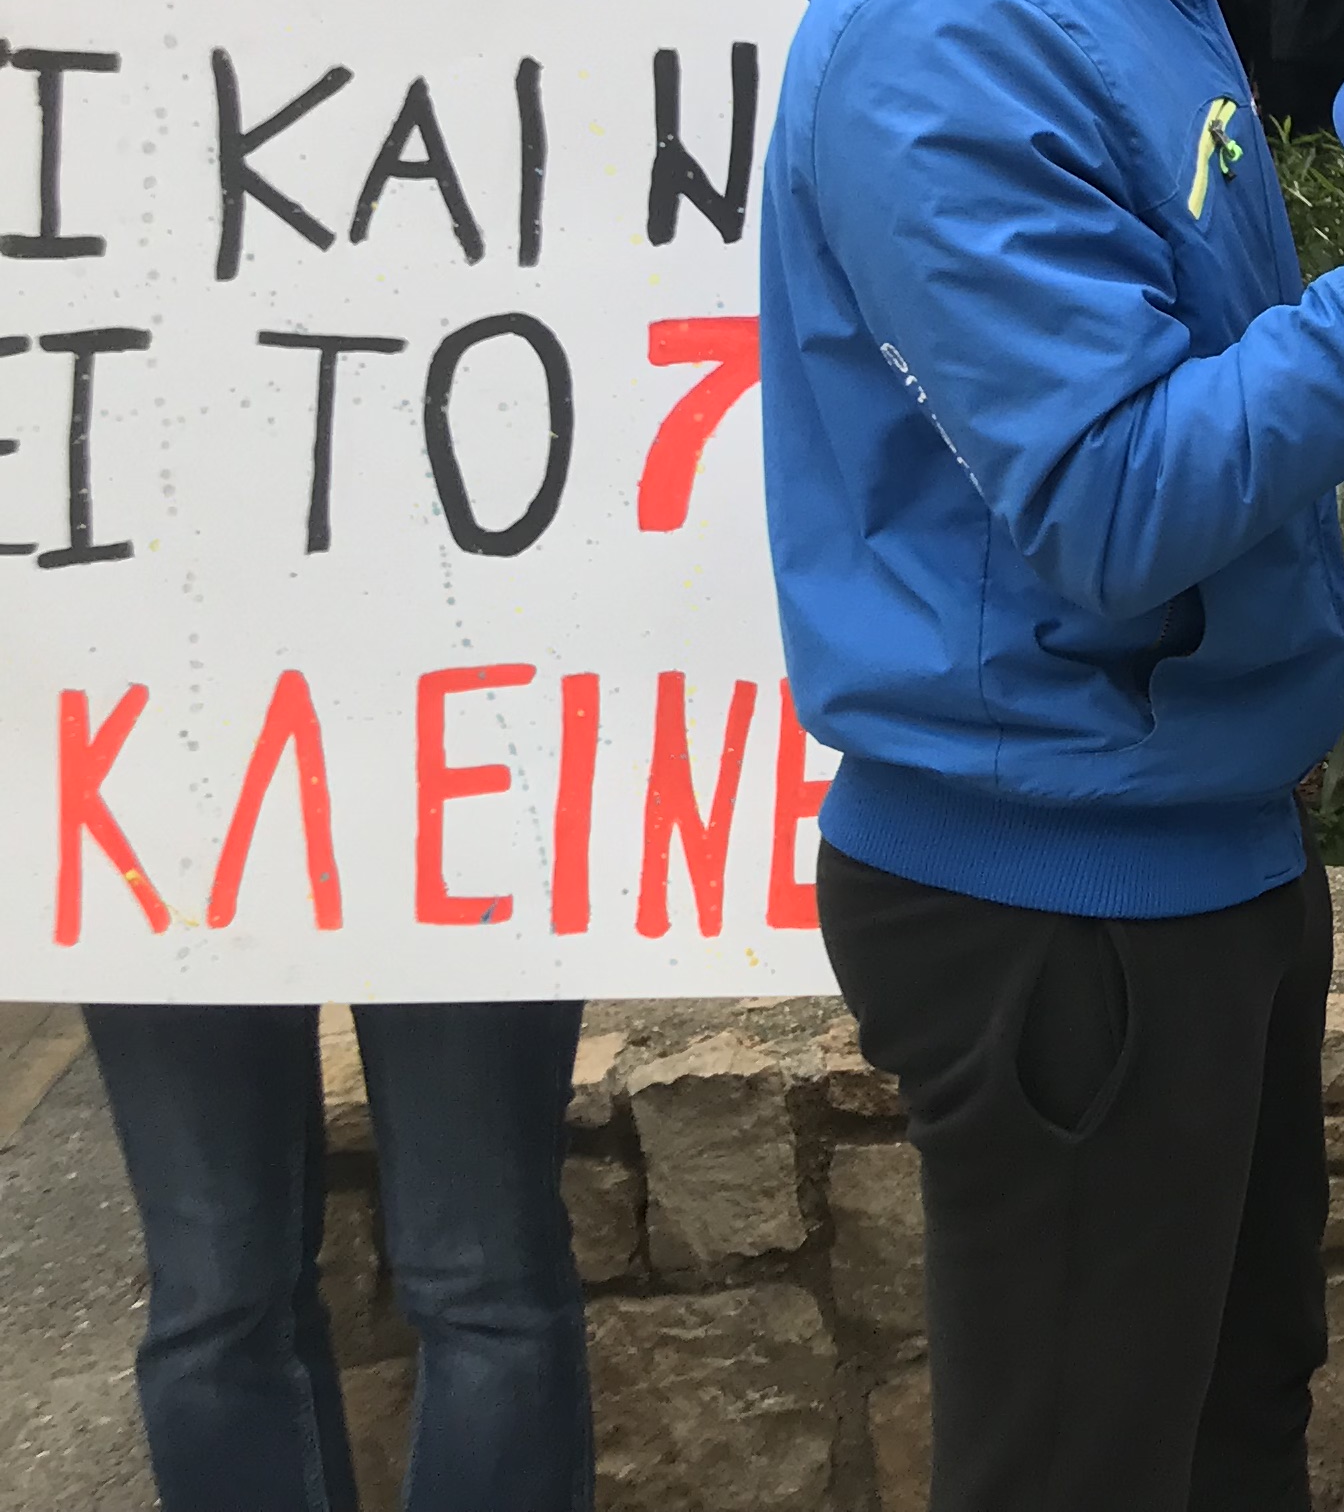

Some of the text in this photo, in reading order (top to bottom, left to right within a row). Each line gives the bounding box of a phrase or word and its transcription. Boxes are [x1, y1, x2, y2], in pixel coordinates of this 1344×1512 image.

[212, 50, 544, 279] ΚΑΙ
[259, 313, 573, 556] ΤΟ
[56, 664, 831, 945] ΚΛΕΙΝΕ
